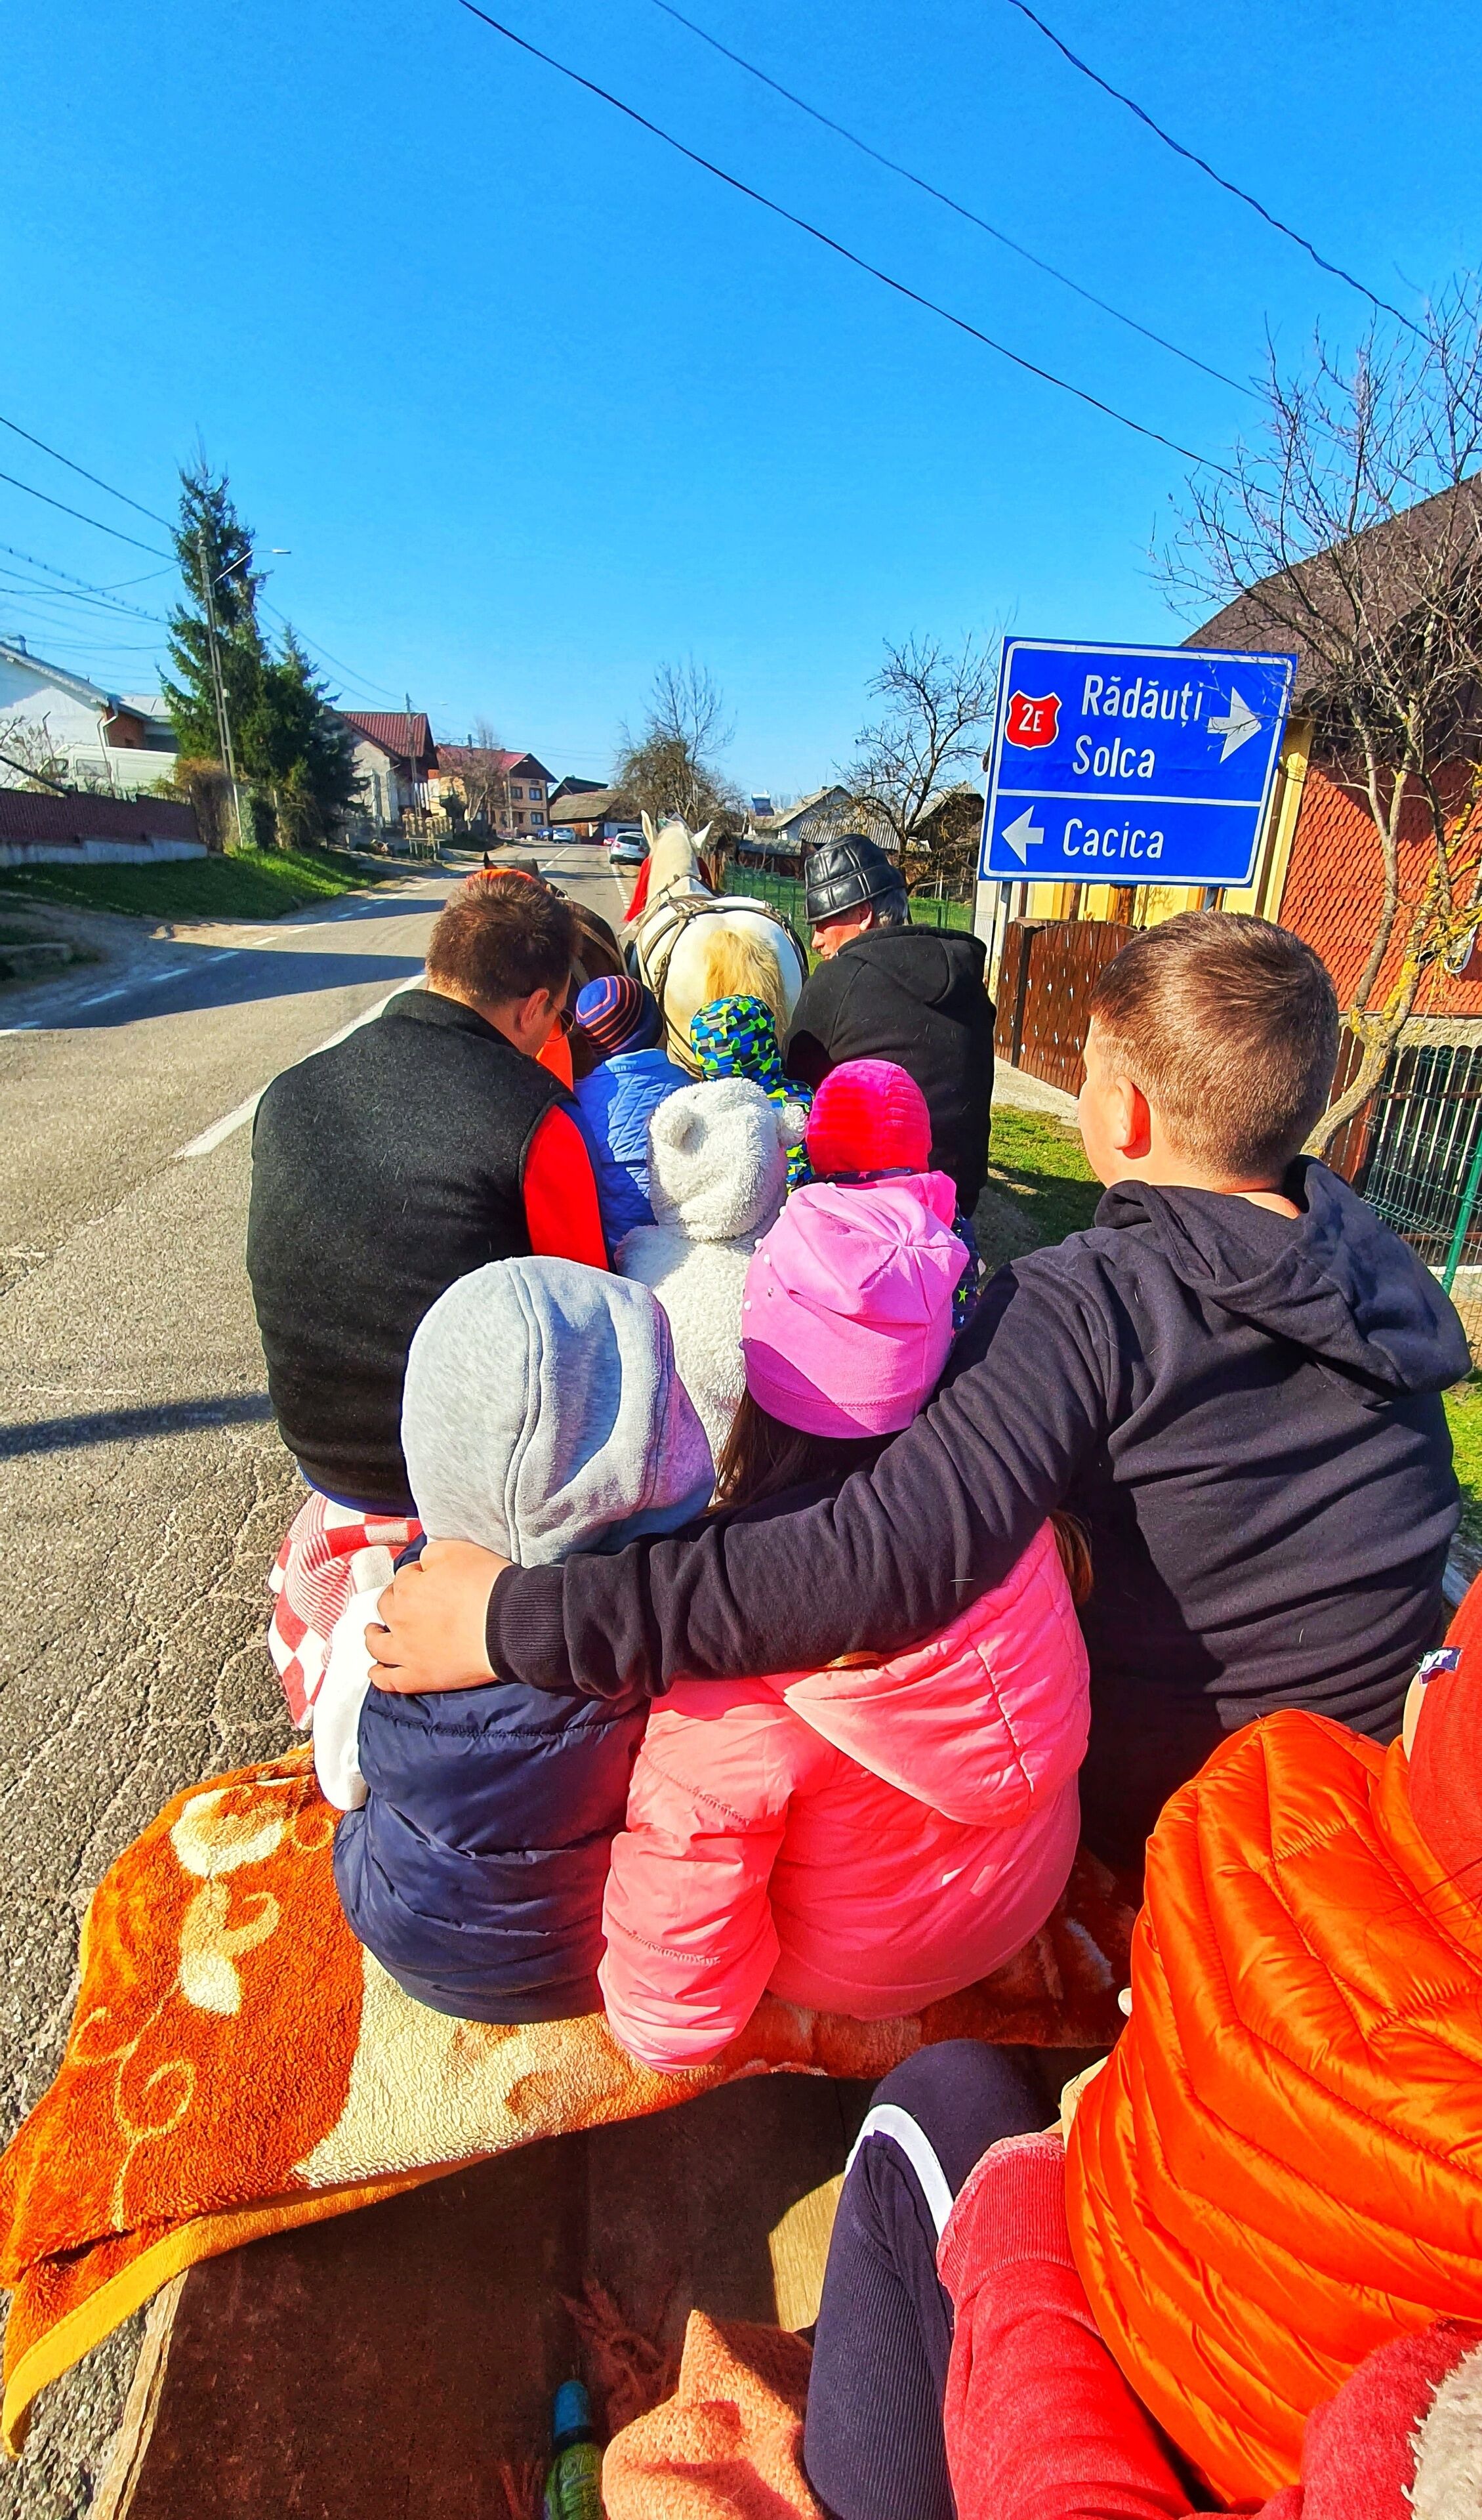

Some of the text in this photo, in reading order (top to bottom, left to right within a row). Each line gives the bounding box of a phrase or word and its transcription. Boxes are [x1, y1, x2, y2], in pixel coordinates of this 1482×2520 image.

[1018, 703, 1044, 732] 2E
[1081, 675, 1204, 728] Rădăuți
[1072, 734, 1155, 778] Solca
[1063, 818, 1164, 858] Cacica
